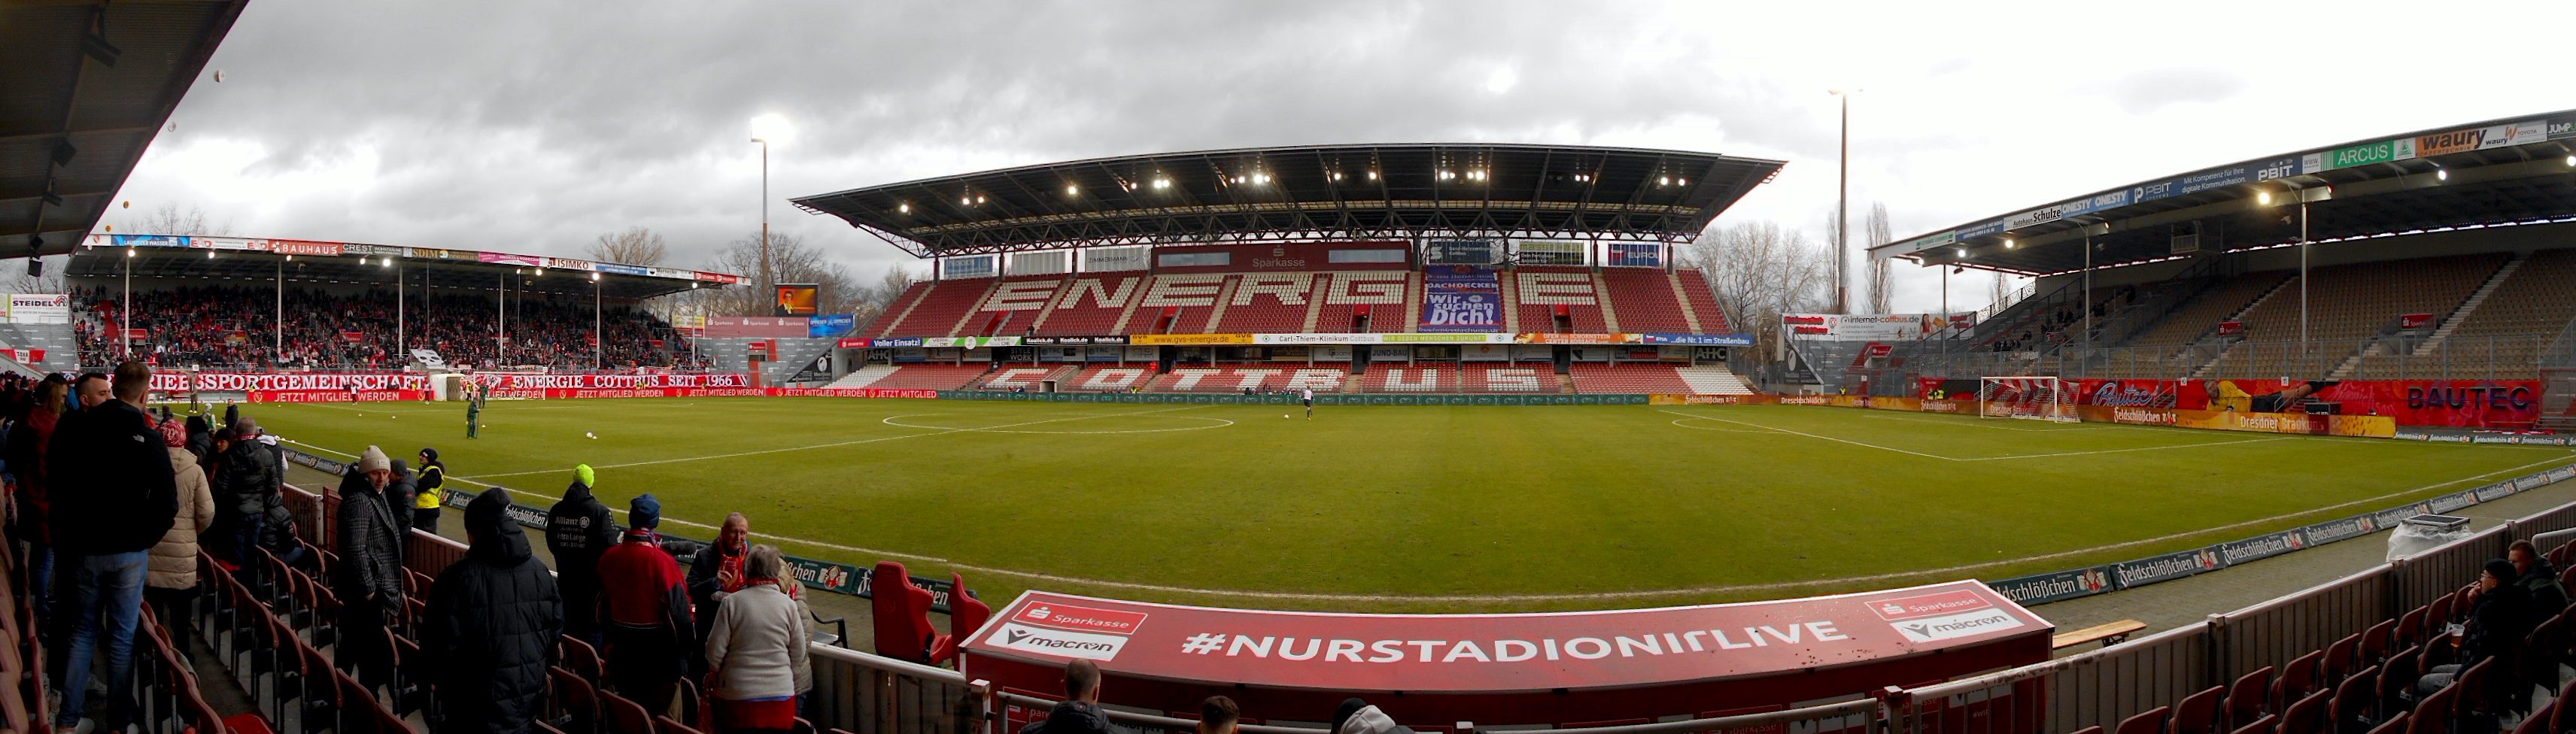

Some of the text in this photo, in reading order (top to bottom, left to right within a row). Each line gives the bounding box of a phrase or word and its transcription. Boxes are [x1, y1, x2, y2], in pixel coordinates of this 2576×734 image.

[2423, 129, 2487, 150] waury
[2338, 144, 2389, 165] ARCUS
[2192, 172, 2224, 184] Kompetenz
[2182, 176, 2246, 194] digitale Kommunikation.
[2095, 190, 2128, 206] ONESTY
[2061, 199, 2092, 214] ONESTY
[2013, 208, 2061, 227] Autohaus Schulze
[282, 244, 337, 254] BAUHAUS
[413, 248, 437, 258] SDIM
[557, 259, 589, 269] ISIMKO
[1253, 258, 1305, 268] Sparkasse
[980, 271, 1596, 312] ENERGE
[1429, 294, 1460, 304] Wir
[1434, 302, 1494, 311] suchen
[1430, 308, 1493, 325] Dich!
[894, 338, 920, 347] Einsatz!
[1153, 335, 1229, 344] www.gvs-energie.de
[1372, 349, 1408, 357] JUNO-BAU
[1696, 347, 1727, 359] AHC
[512, 375, 733, 389] ENERGIE COTTBUS SEIT 1966
[275, 393, 305, 403] JETZT
[357, 391, 399, 401] WERDEN
[575, 389, 664, 399] JETZT MITGLIED WERDEN
[688, 389, 707, 397] JETZT
[737, 388, 764, 396] WERDEN
[804, 389, 835, 397] MITGLIED
[837, 389, 866, 397] WERDEN
[877, 390, 937, 399] JETZT MITGLIED
[2408, 387, 2531, 410] BAUTEC
[2113, 407, 2161, 423] Feldschlößchen
[2240, 416, 2278, 429] Dresdner
[555, 516, 579, 526] Allianz
[570, 532, 585, 543] Lange
[2306, 520, 2357, 546] Feldschlößchen
[2222, 539, 2284, 565] Feldschlößchen
[2117, 557, 2194, 588] Feldschlößchen
[1997, 578, 2076, 602] ldschlößchen
[1909, 595, 1979, 614] Sparkasse
[1052, 613, 1130, 629] Sparkasse
[1933, 612, 2009, 634] macron
[1028, 635, 1114, 654] macron
